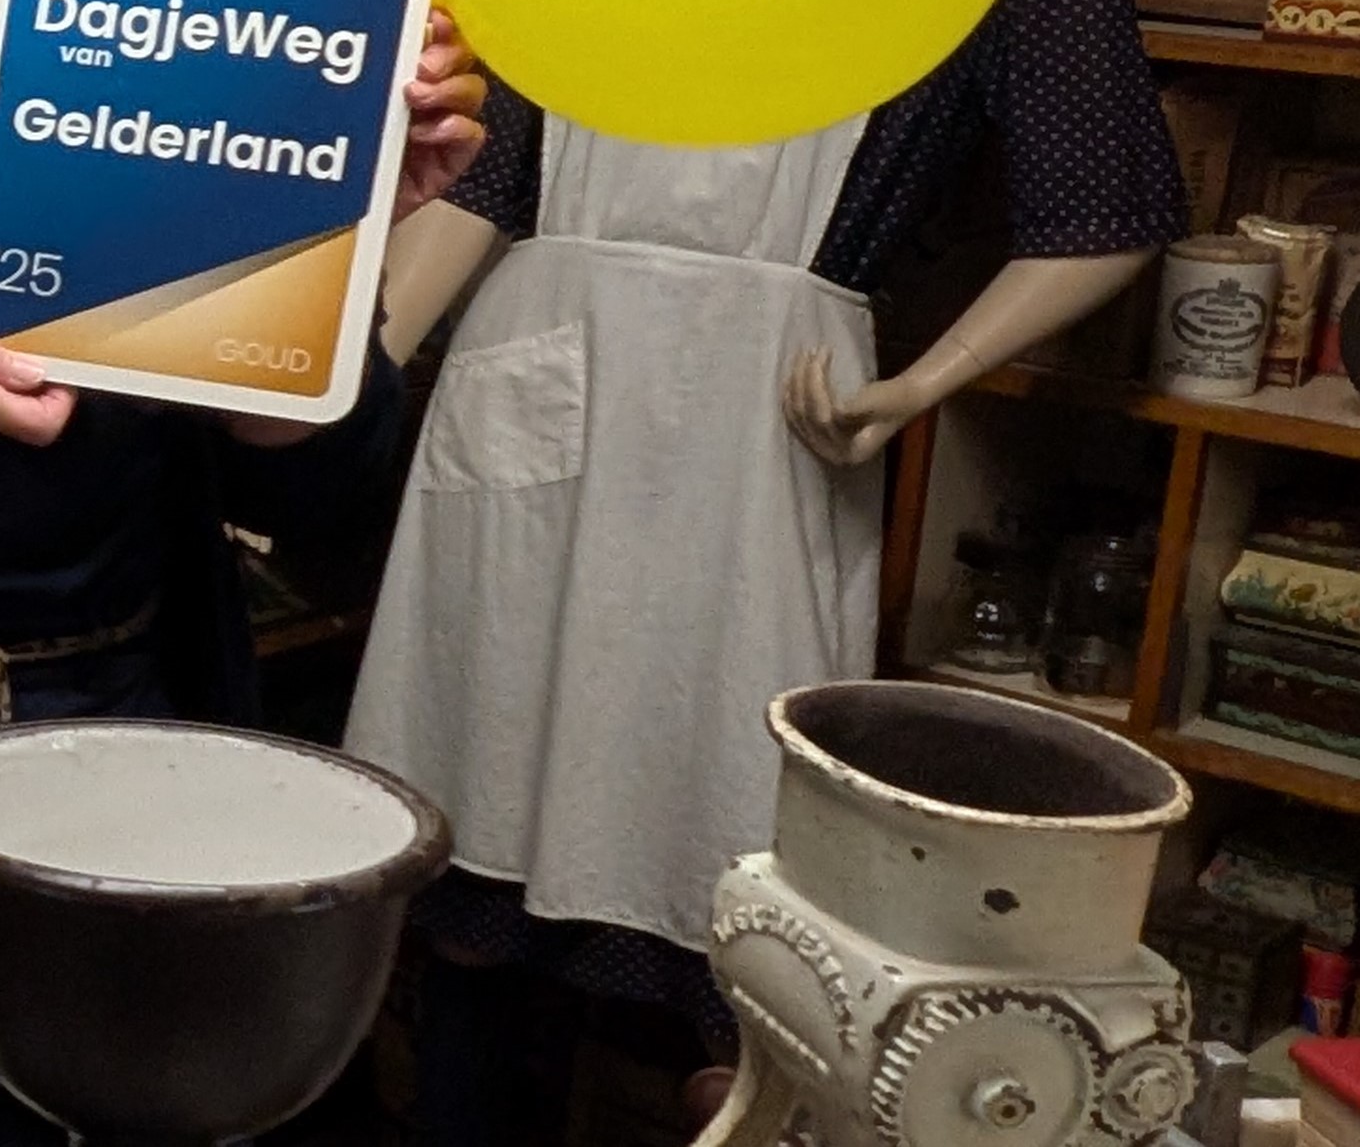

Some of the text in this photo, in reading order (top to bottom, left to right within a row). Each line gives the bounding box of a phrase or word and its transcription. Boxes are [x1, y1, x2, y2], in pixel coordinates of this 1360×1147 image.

[59, 44, 113, 69] van
[12, 97, 350, 183] Gelderland
[215, 338, 312, 375] GOUD
